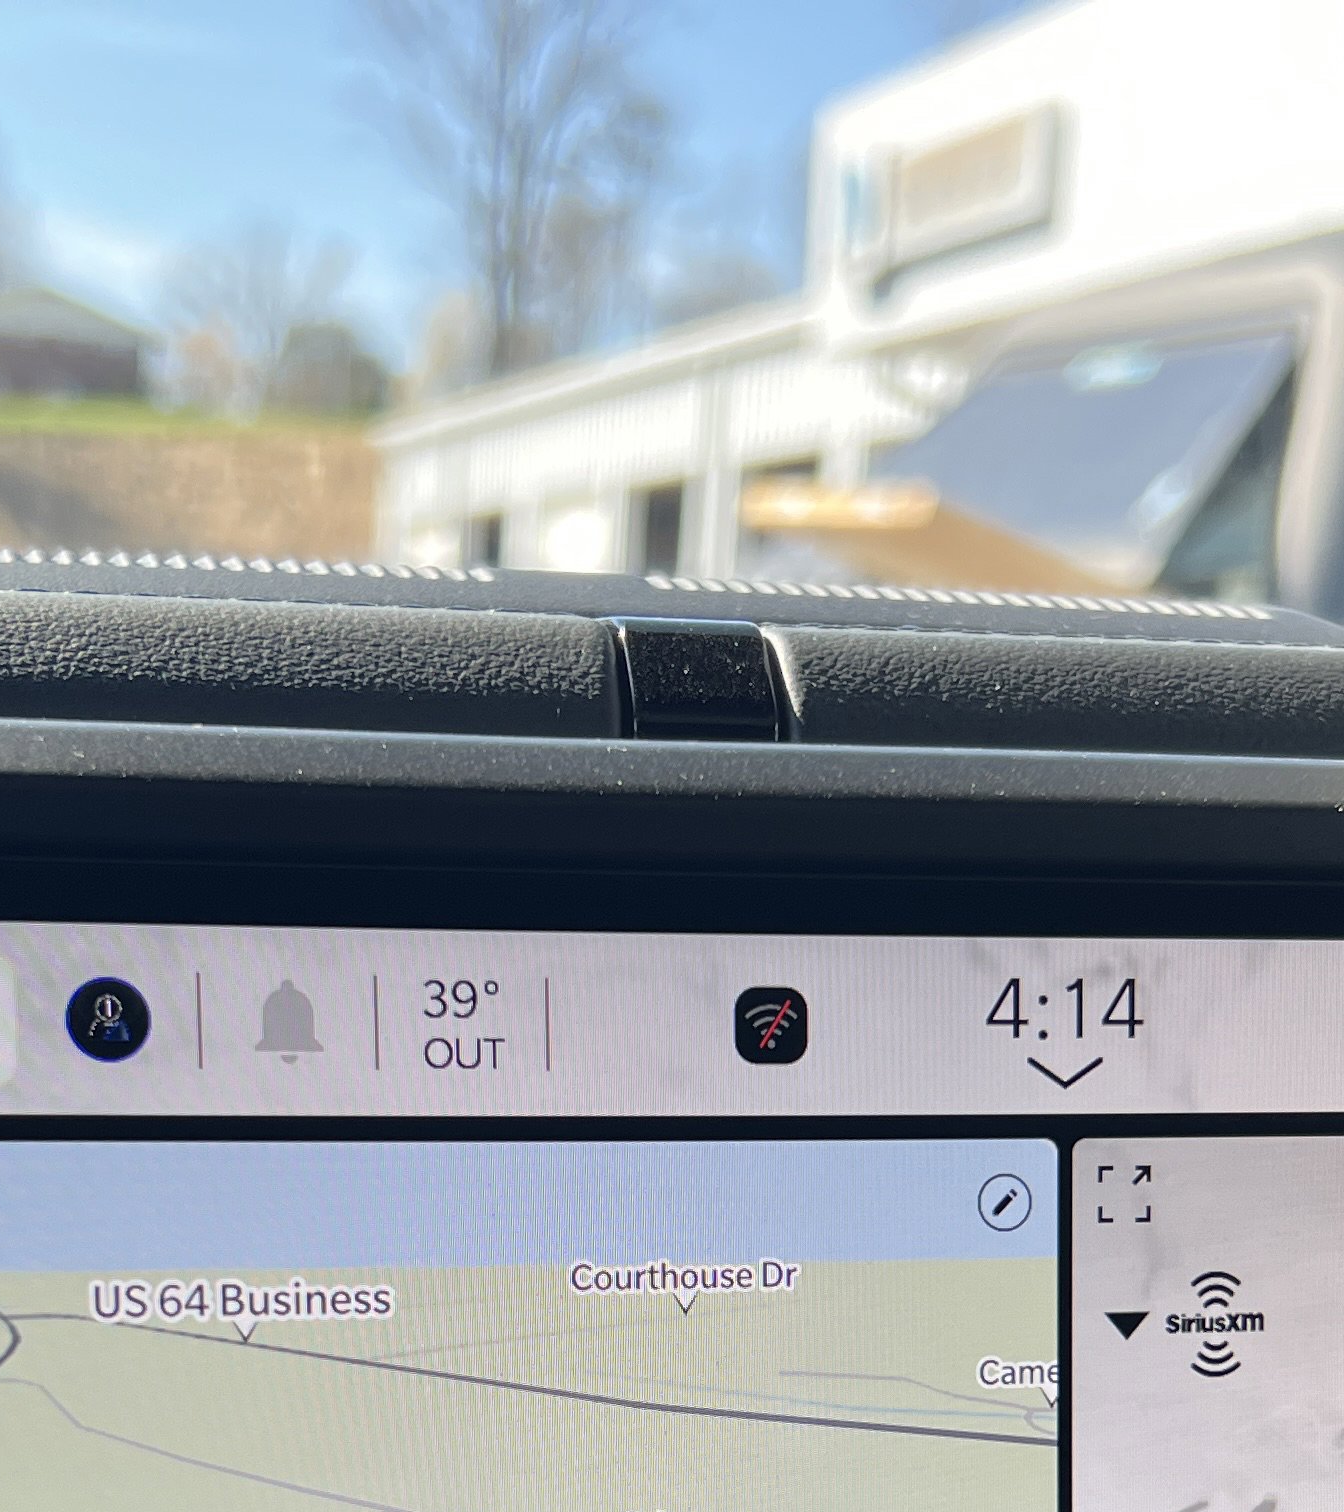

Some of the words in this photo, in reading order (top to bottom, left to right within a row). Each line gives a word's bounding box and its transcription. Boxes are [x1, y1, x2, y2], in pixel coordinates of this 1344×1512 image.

[422, 979, 500, 1019] 39°
[985, 977, 1144, 1040] 4:14
[423, 1037, 506, 1071] OUT
[571, 1263, 752, 1291] Courthouse
[762, 1262, 797, 1288] Dr
[93, 1285, 147, 1318] US
[158, 1284, 210, 1317] 64
[221, 1282, 392, 1316] Business
[979, 1359, 1058, 1386] Came
